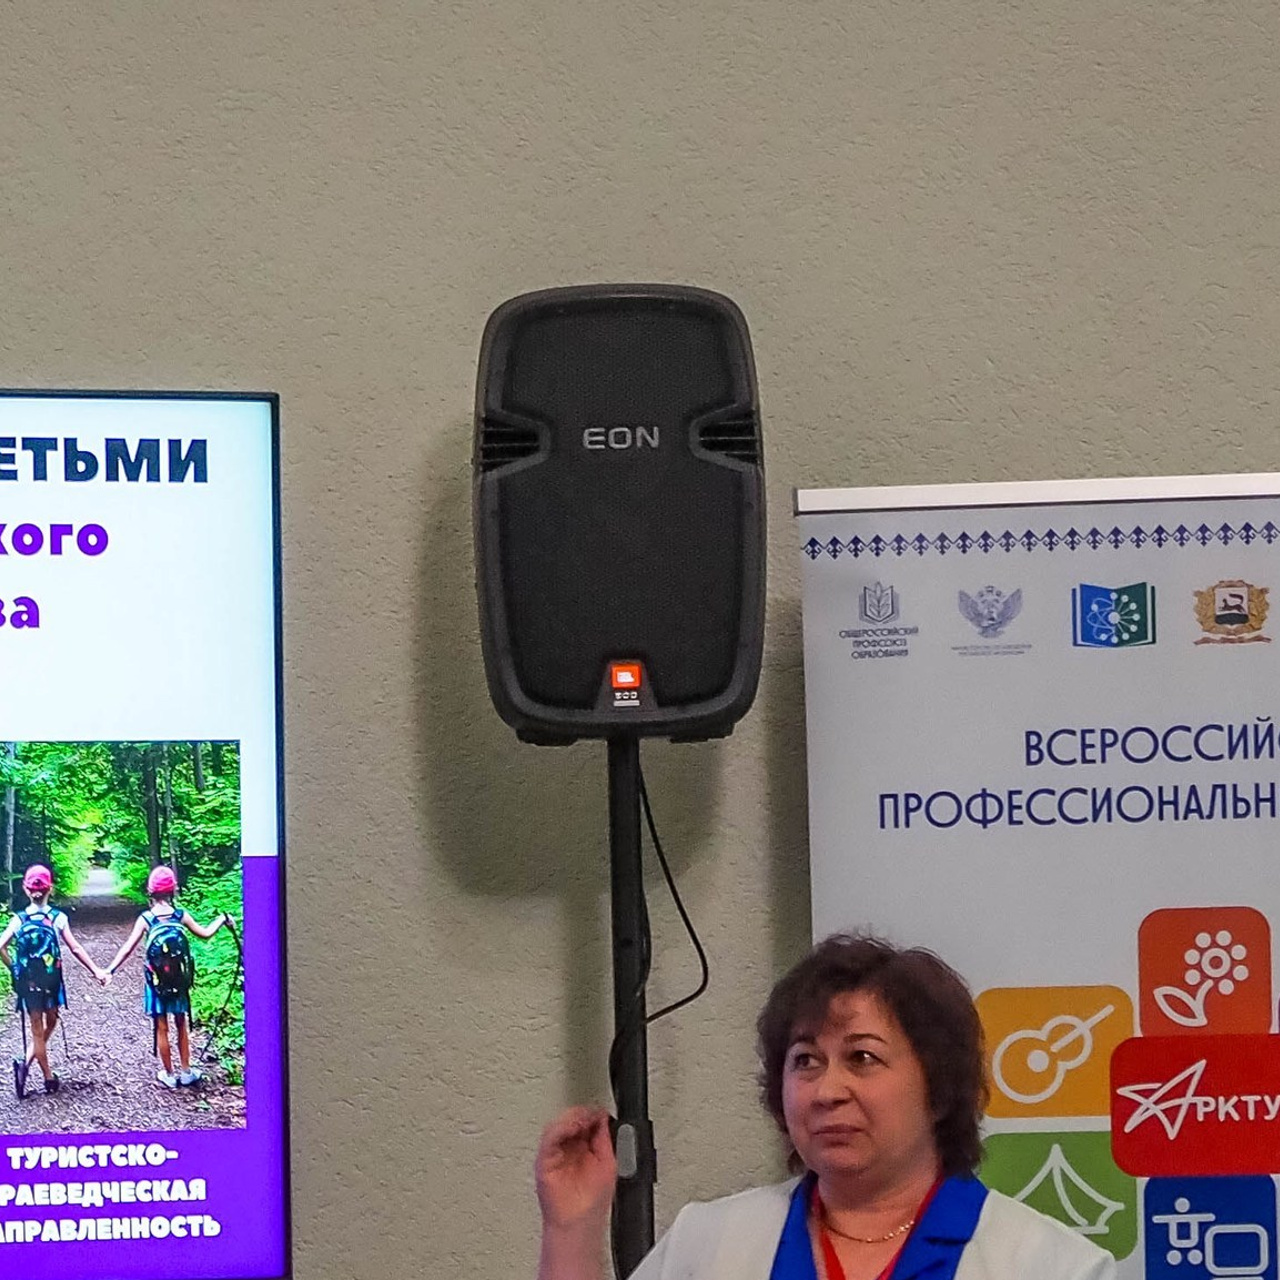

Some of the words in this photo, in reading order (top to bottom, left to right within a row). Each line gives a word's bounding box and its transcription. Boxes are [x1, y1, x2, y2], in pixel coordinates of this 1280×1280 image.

[582, 426, 660, 449] EON
[1024, 716, 1280, 767] ВСЕРОССИЙ
[879, 782, 1276, 830] ПРОФЕССИОНАЛЬН
[6, 1144, 179, 1170] ТУРИСТСКО-
